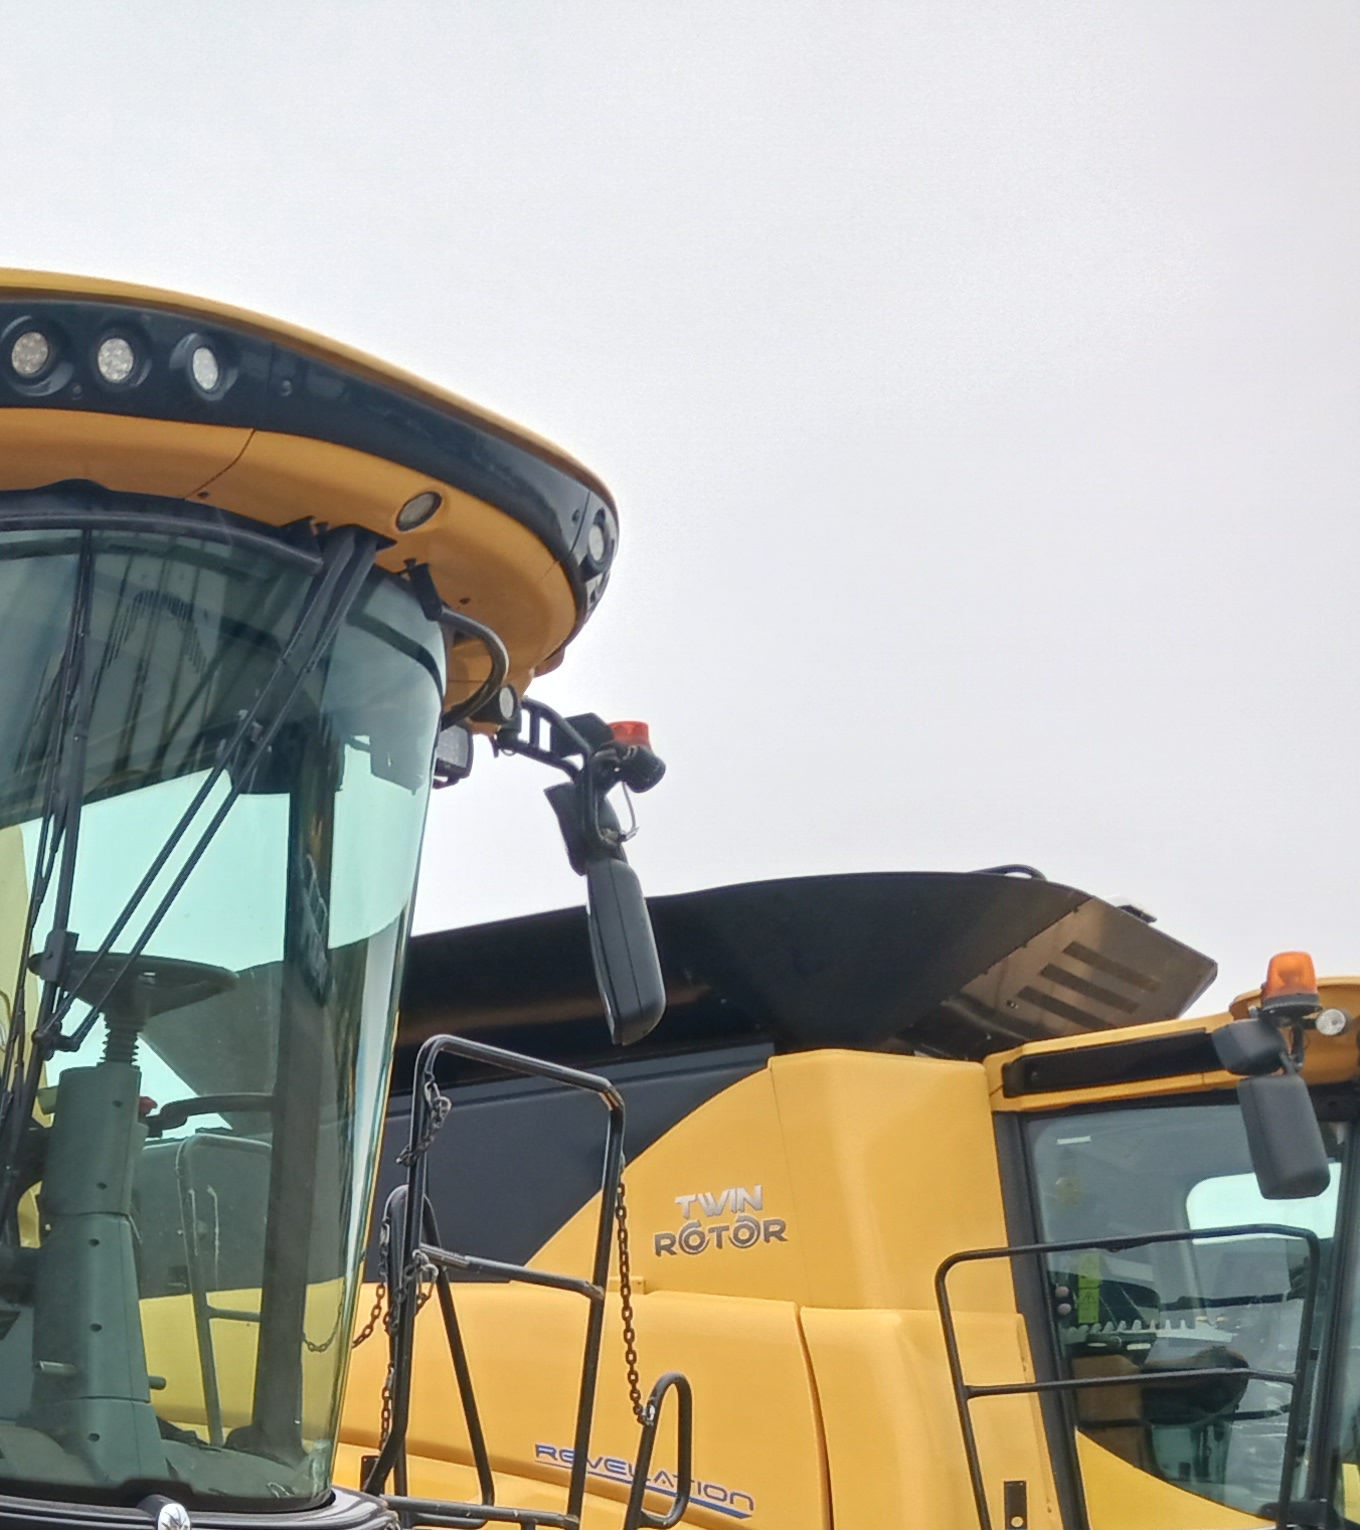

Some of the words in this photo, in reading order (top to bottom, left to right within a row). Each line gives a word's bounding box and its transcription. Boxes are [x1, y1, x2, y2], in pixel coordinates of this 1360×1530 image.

[675, 1184, 763, 1220] TWIN
[653, 1214, 789, 1258] ROTOR
[534, 1443, 755, 1512] REVELAION
